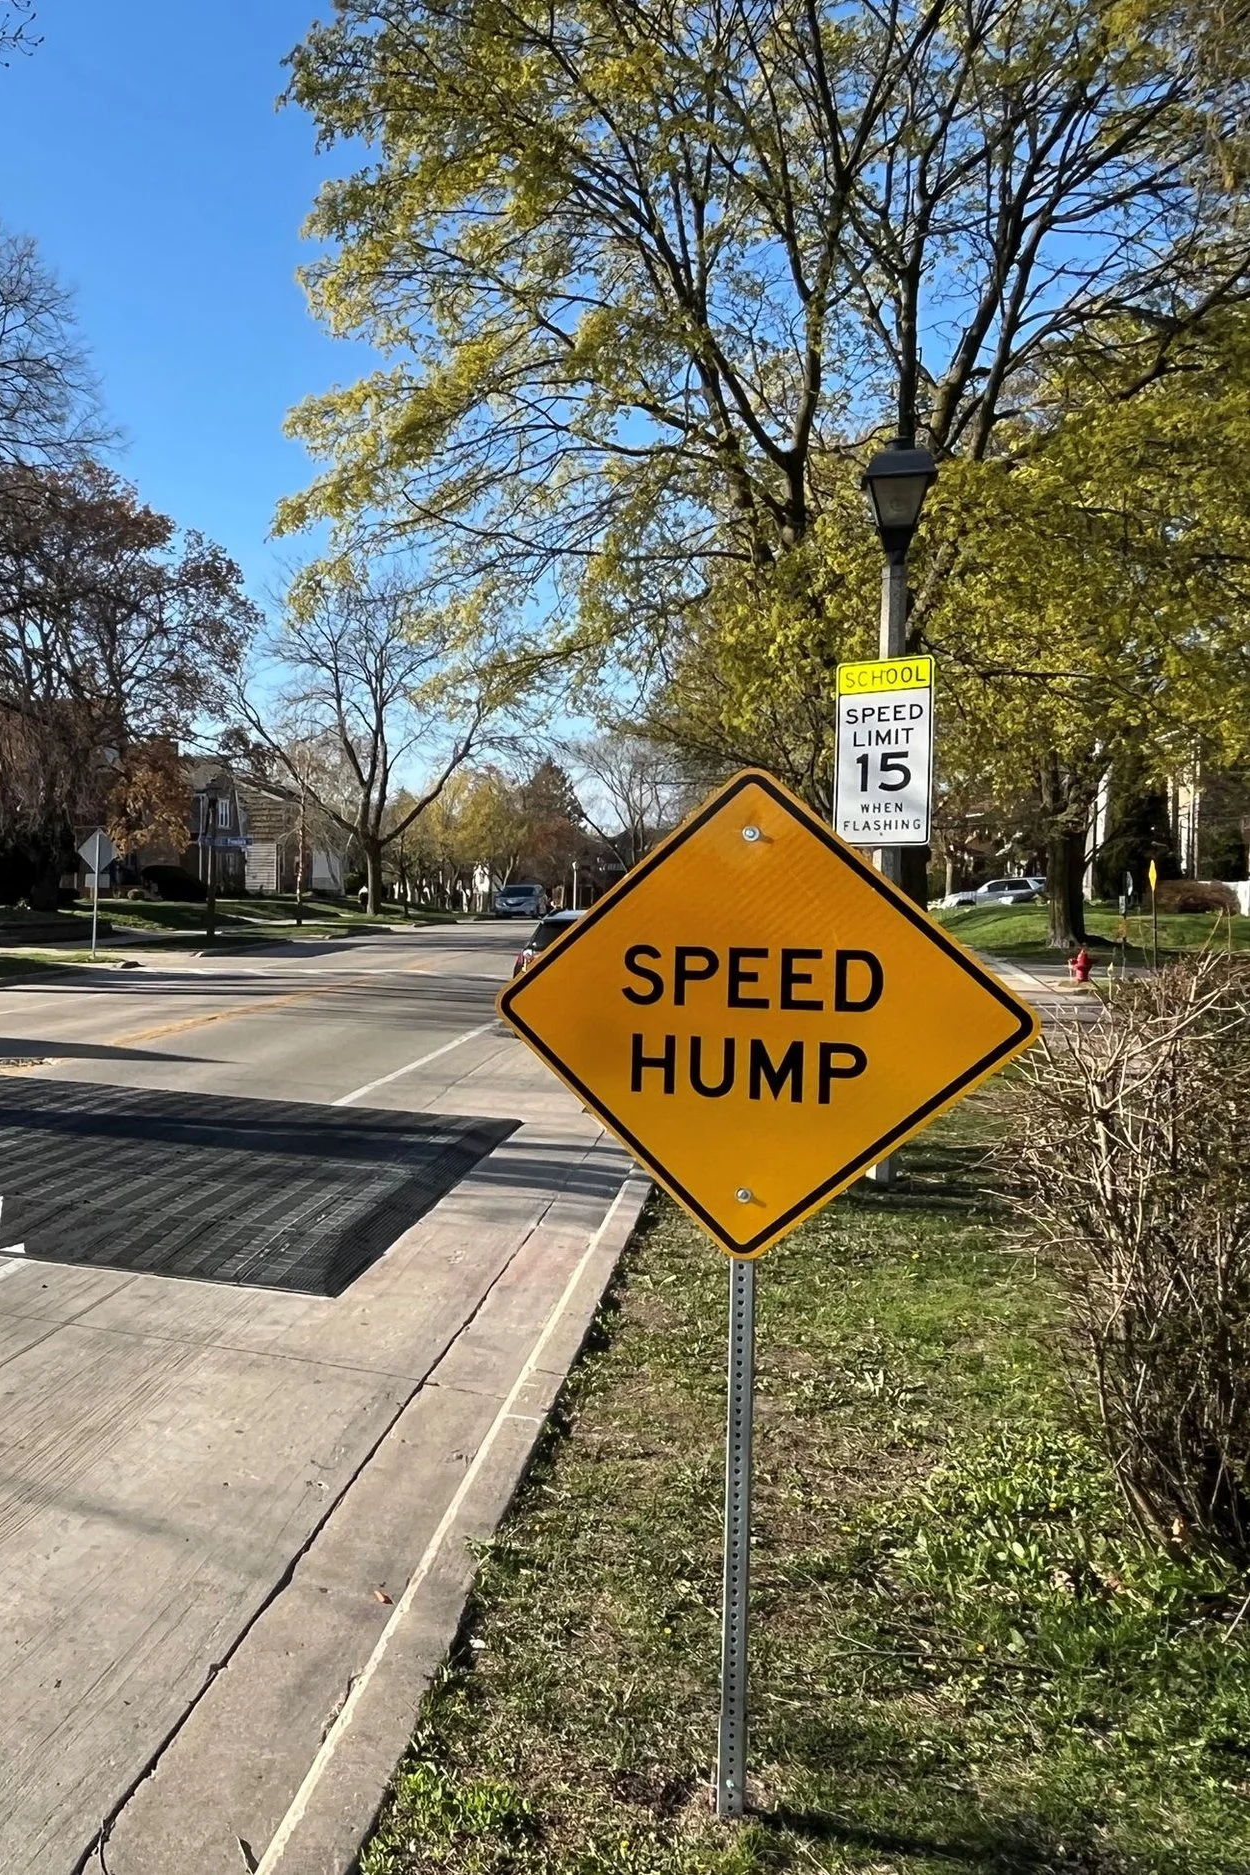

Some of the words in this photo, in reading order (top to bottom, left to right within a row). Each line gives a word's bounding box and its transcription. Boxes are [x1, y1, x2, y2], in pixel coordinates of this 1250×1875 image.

[845, 665, 927, 688] SCHOOL
[845, 703, 924, 725] SPEED
[853, 727, 915, 748] LIMIT
[856, 751, 912, 792] 15
[860, 802, 904, 814] WHEN
[843, 819, 922, 832] FLASHING
[621, 944, 885, 1013] SPEED
[630, 1032, 868, 1105] HUMP
